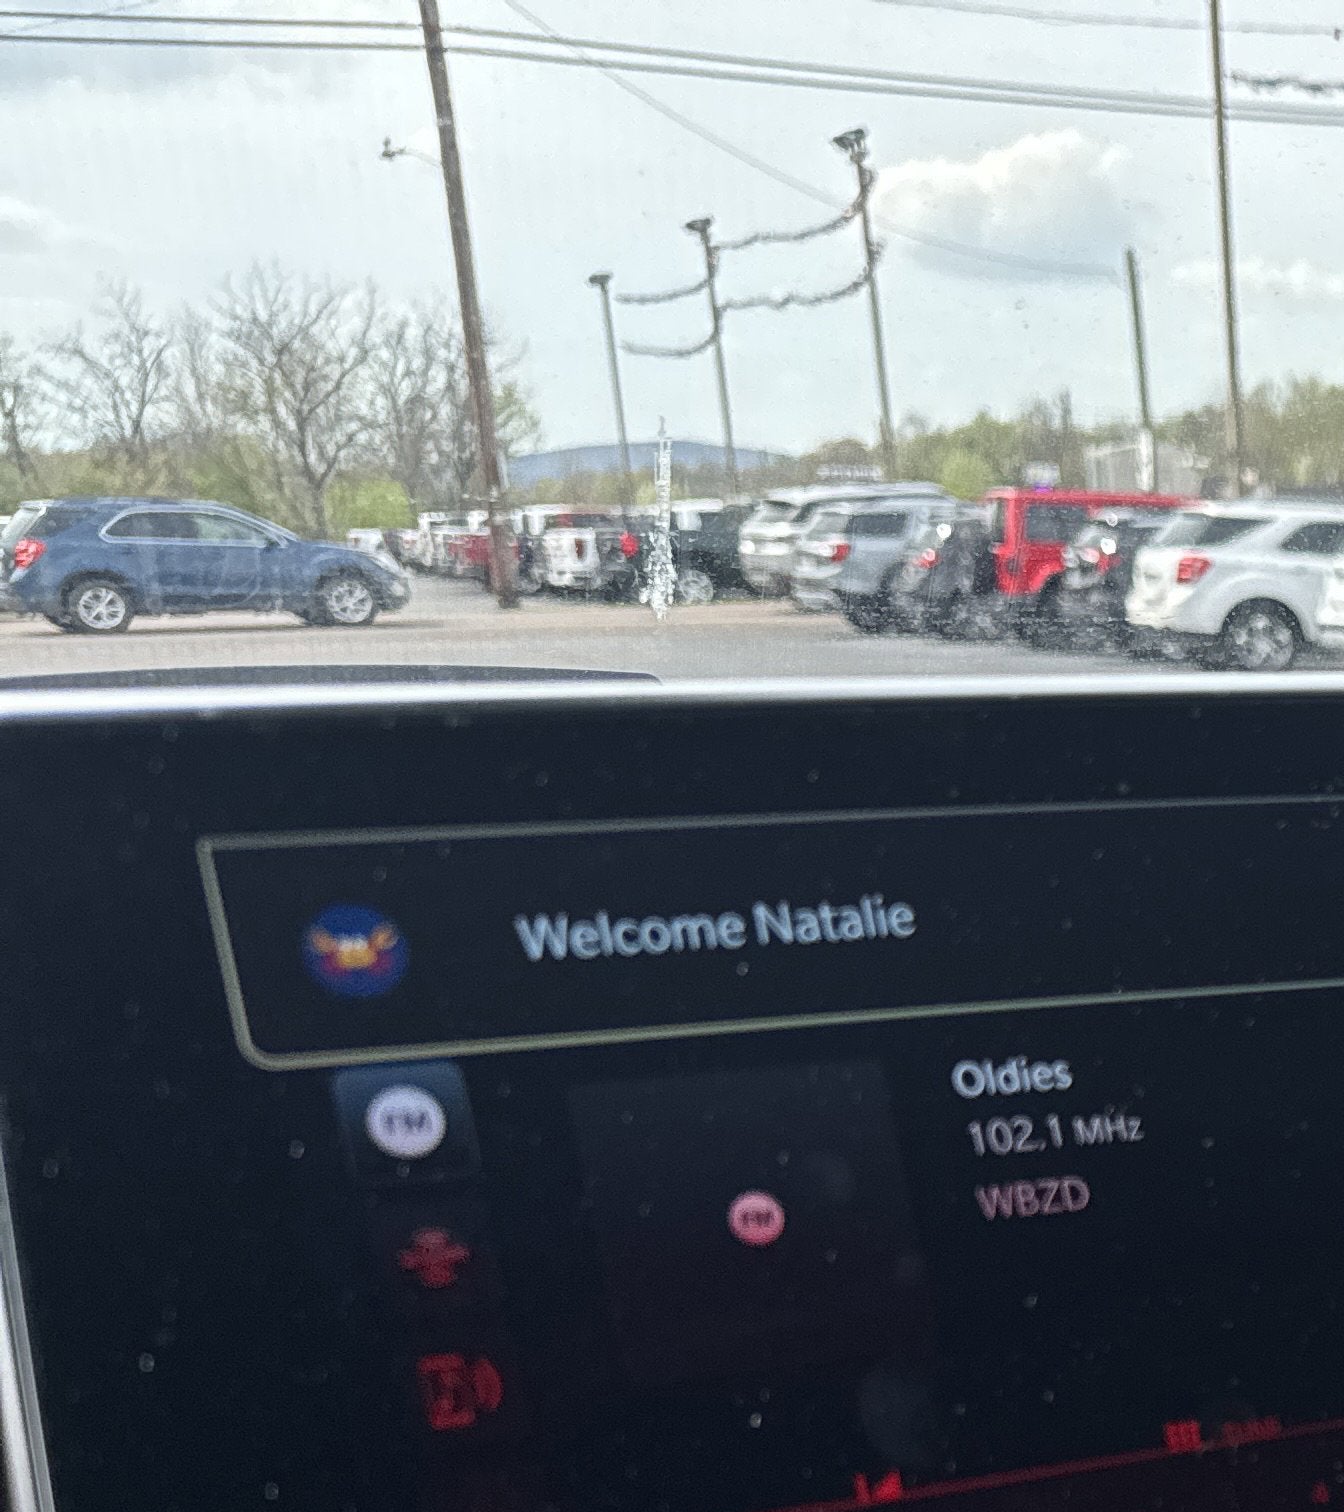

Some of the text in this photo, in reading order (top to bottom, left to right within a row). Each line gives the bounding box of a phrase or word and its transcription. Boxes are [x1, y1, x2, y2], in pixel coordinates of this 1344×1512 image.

[514, 894, 917, 962] Welcome Natalie
[951, 1056, 1073, 1099] Oldies
[967, 1113, 1145, 1156] 102.1 MHz
[974, 1175, 1091, 1221] WBZD
